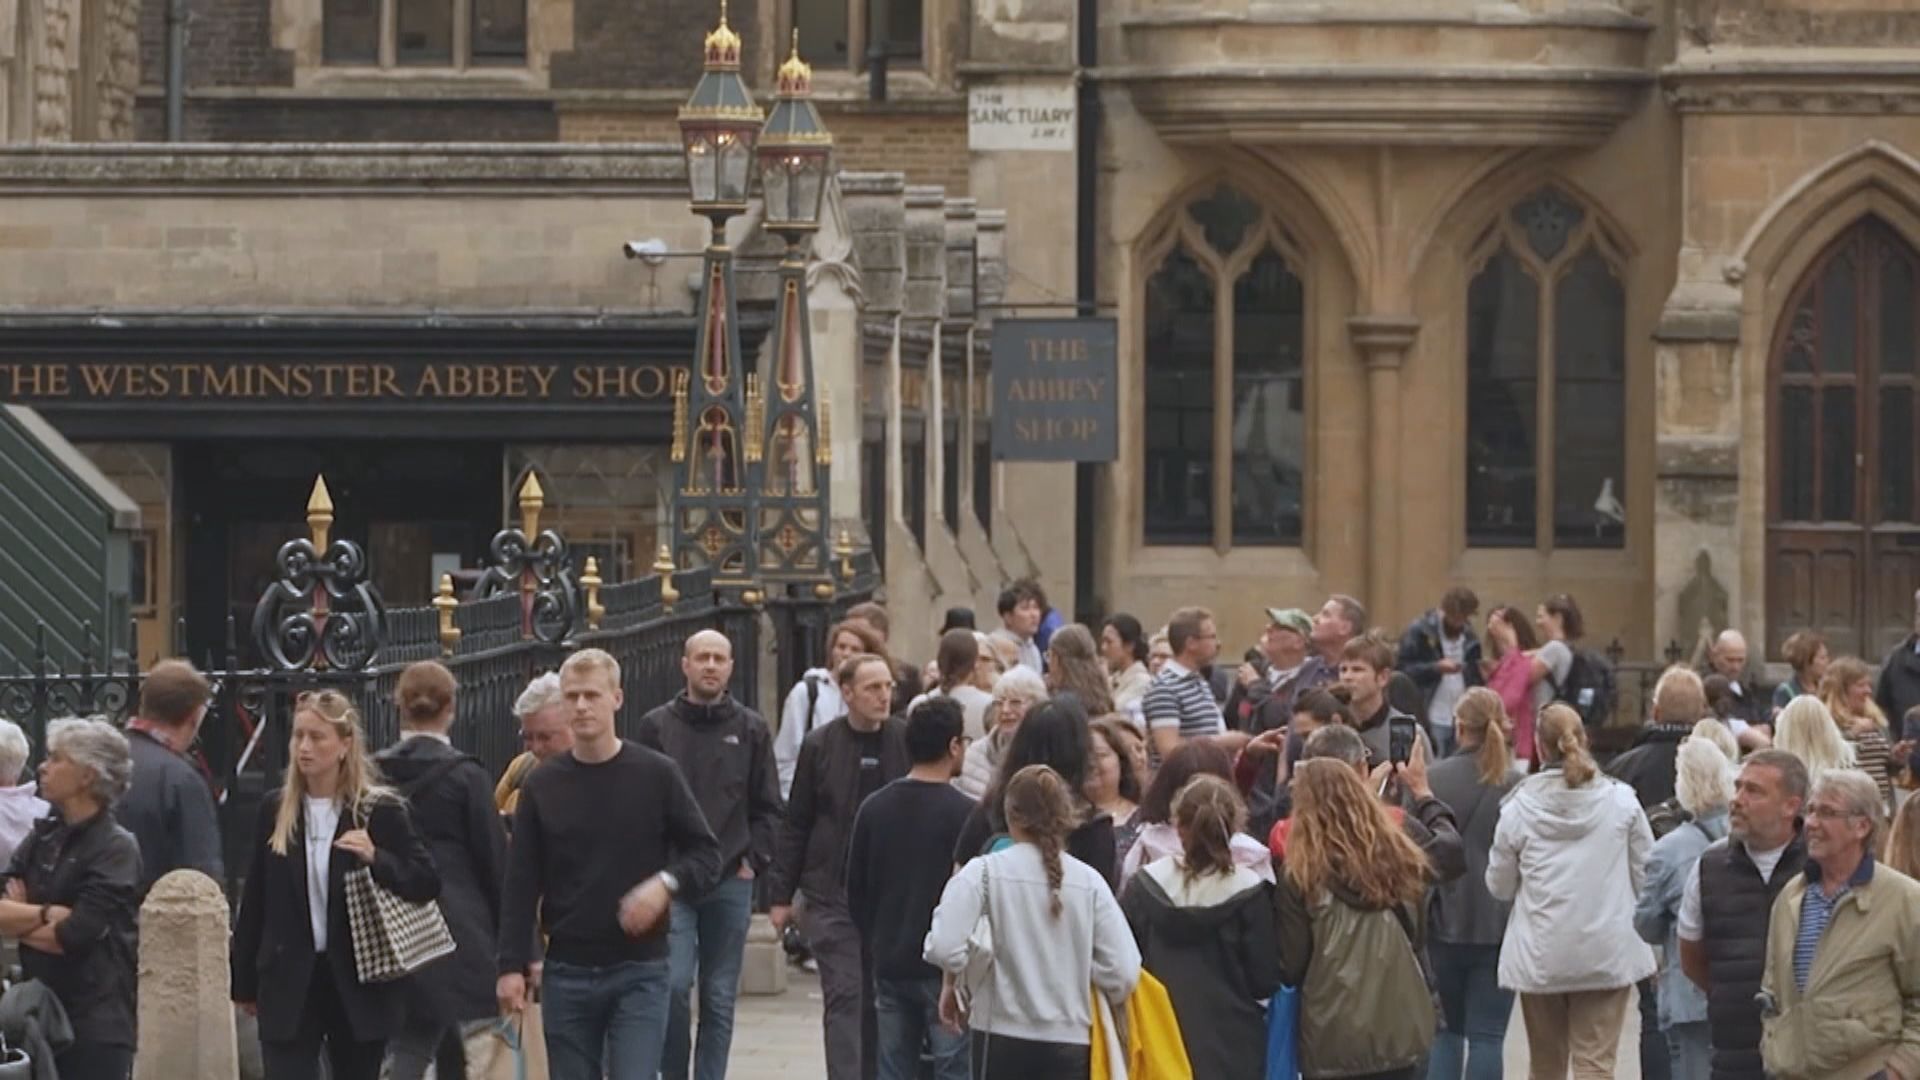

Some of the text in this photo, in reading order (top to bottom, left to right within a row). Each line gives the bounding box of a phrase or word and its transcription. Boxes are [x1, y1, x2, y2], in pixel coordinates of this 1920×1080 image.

[976, 94, 1003, 104] THE
[970, 108, 1074, 124] SANCTUARY
[1027, 338, 1088, 361] THE
[80, 364, 404, 396] WESTMINSTER
[416, 364, 557, 396] ABBEY
[573, 365, 691, 396] SHOP
[1008, 379, 1105, 401] ABBEY
[1014, 418, 1097, 442] SHOP
